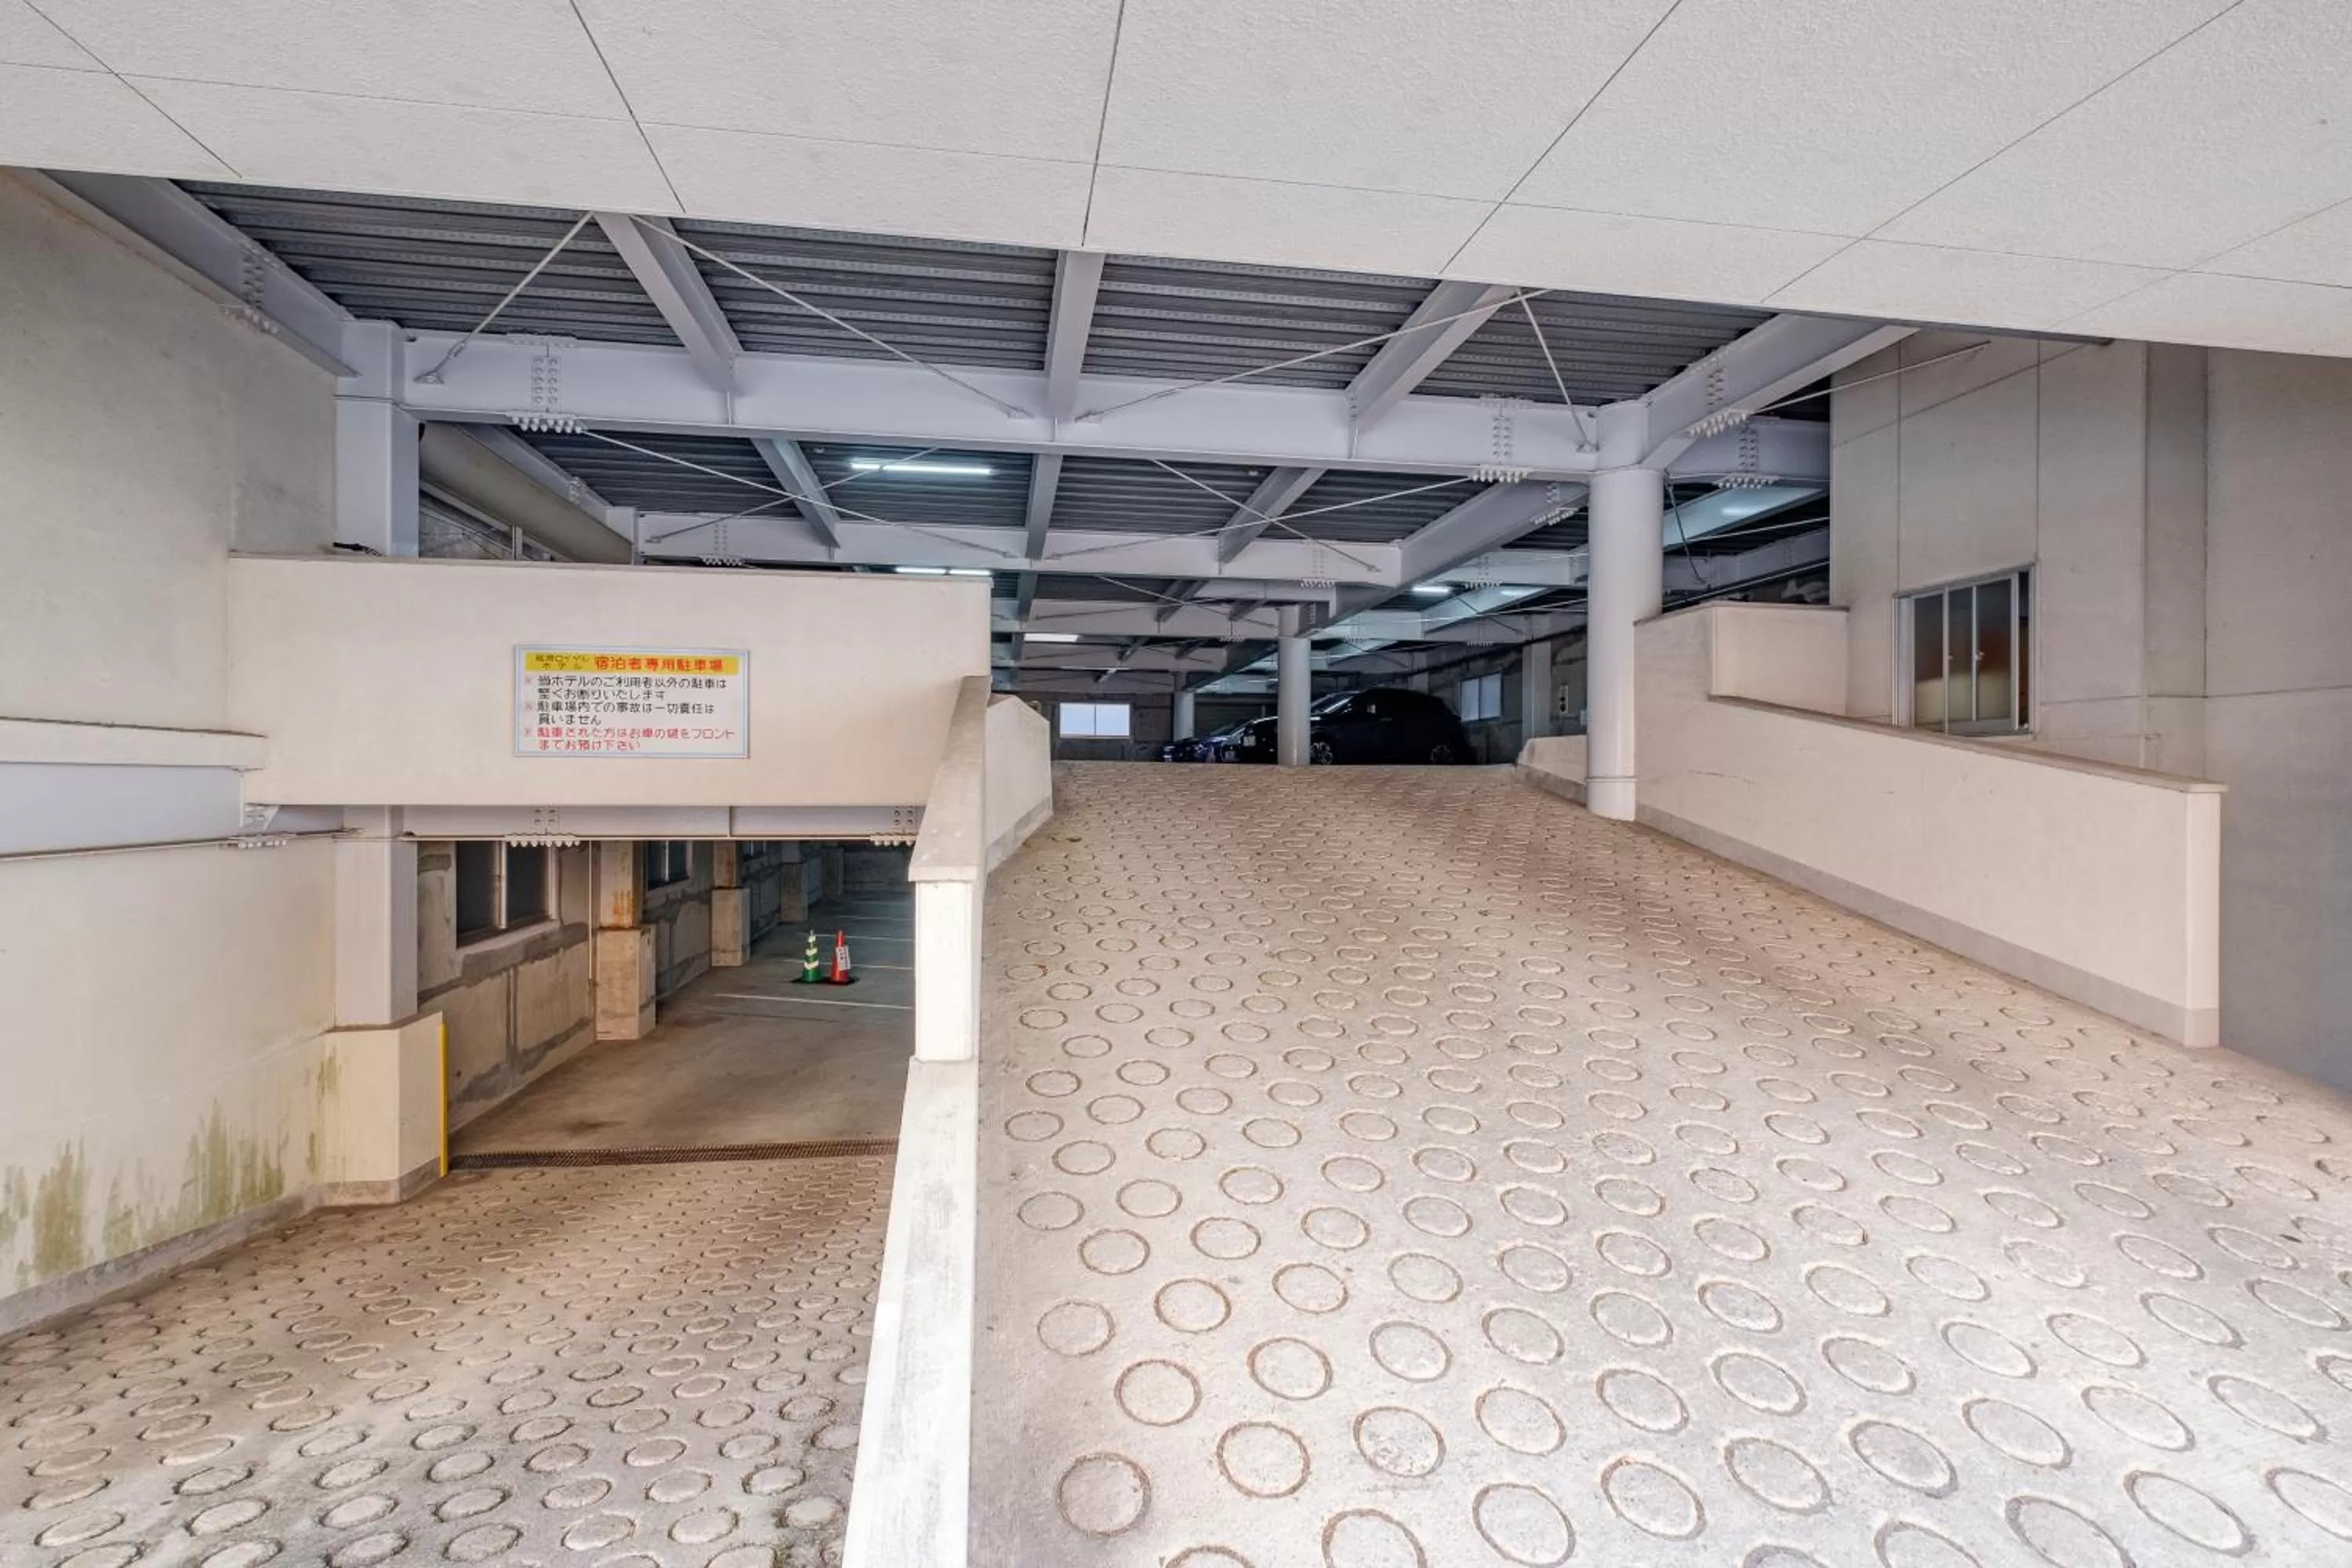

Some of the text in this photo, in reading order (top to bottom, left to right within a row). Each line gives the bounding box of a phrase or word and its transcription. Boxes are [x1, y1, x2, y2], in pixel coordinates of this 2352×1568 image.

[594, 655, 723, 672] 宿泊者専用駐車場
[538, 688, 665, 700] 堅くお断りいたします
[538, 701, 714, 714] 駐車場内での事故は一切責任は
[539, 739, 640, 751] までお預け下さい
